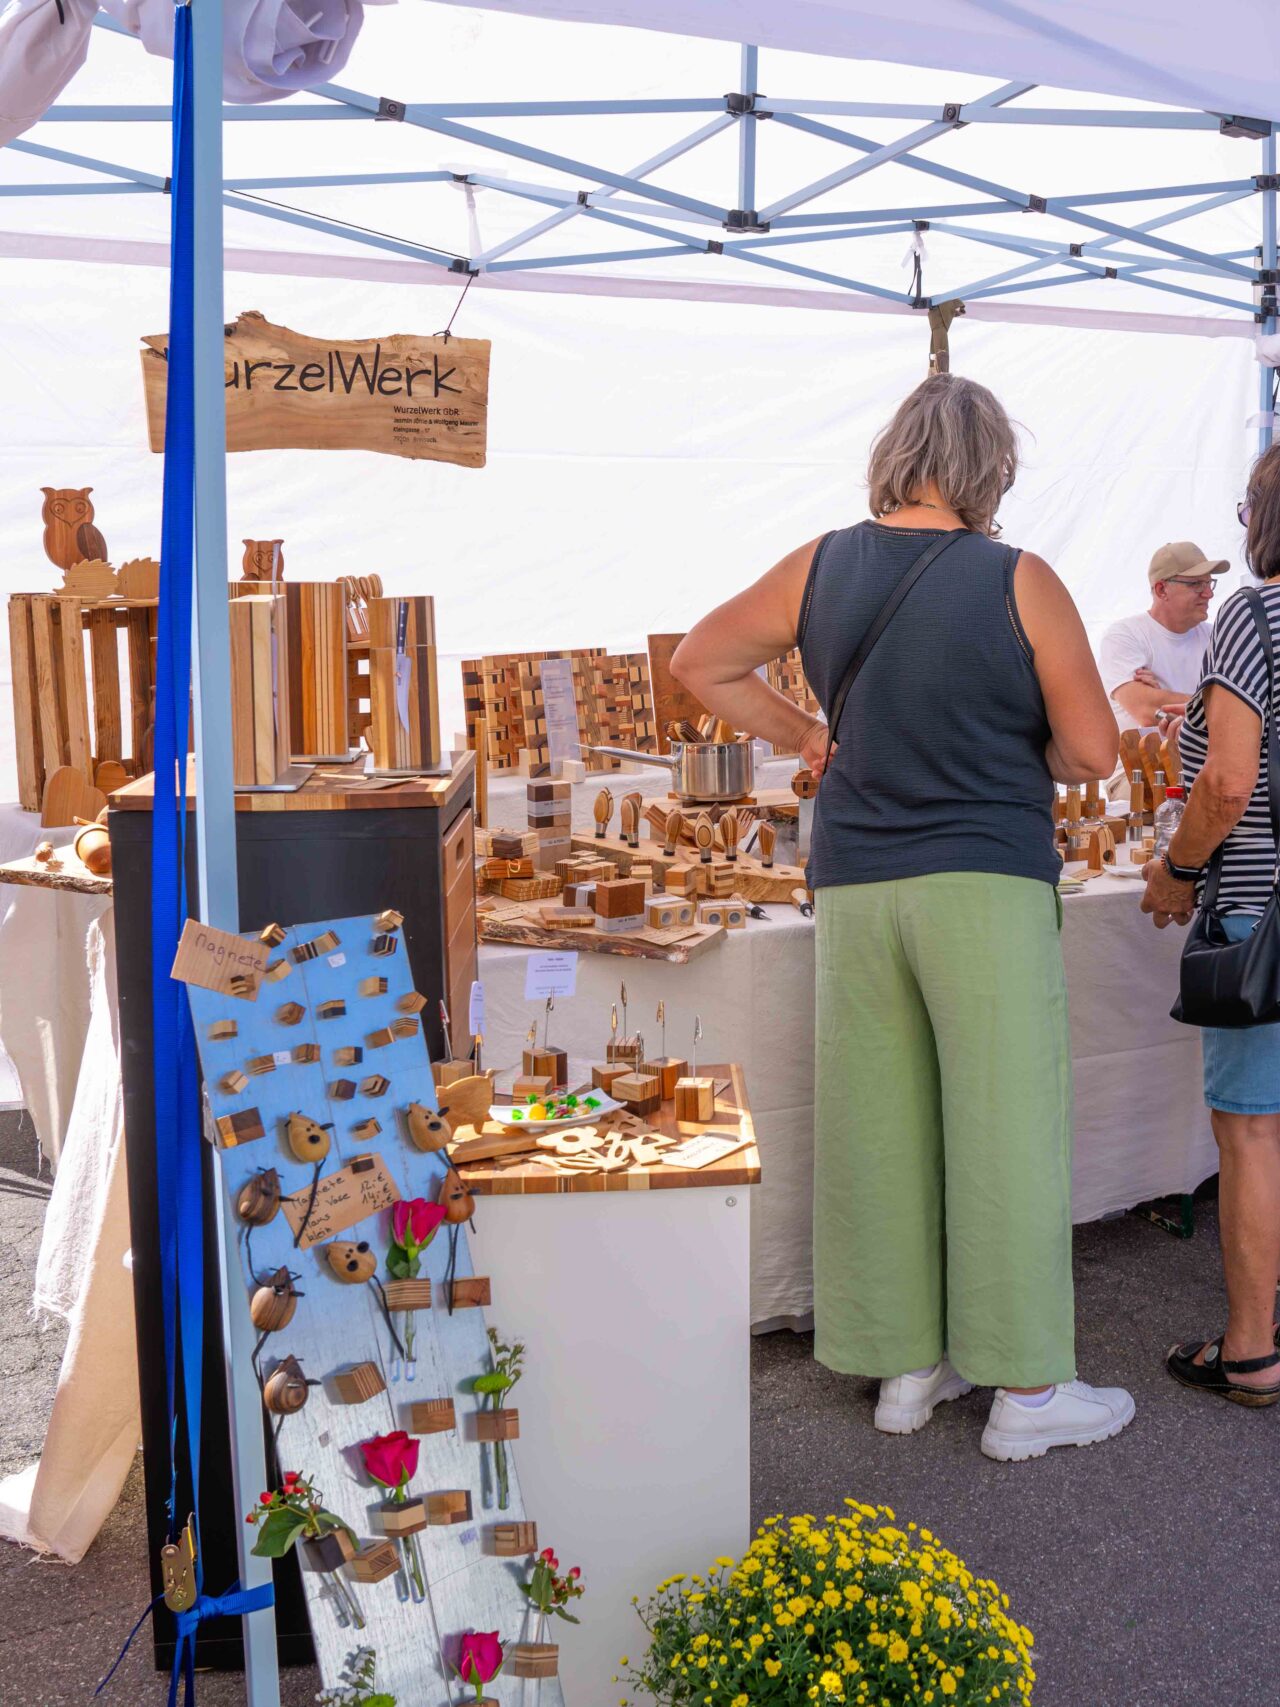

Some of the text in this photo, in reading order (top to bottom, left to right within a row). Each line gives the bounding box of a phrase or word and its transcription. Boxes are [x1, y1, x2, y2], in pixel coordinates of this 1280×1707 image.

[164, 343, 462, 398] urzelWerk
[393, 406, 460, 416] WurzelWerk GbR
[289, 1177, 345, 1210] Magete
